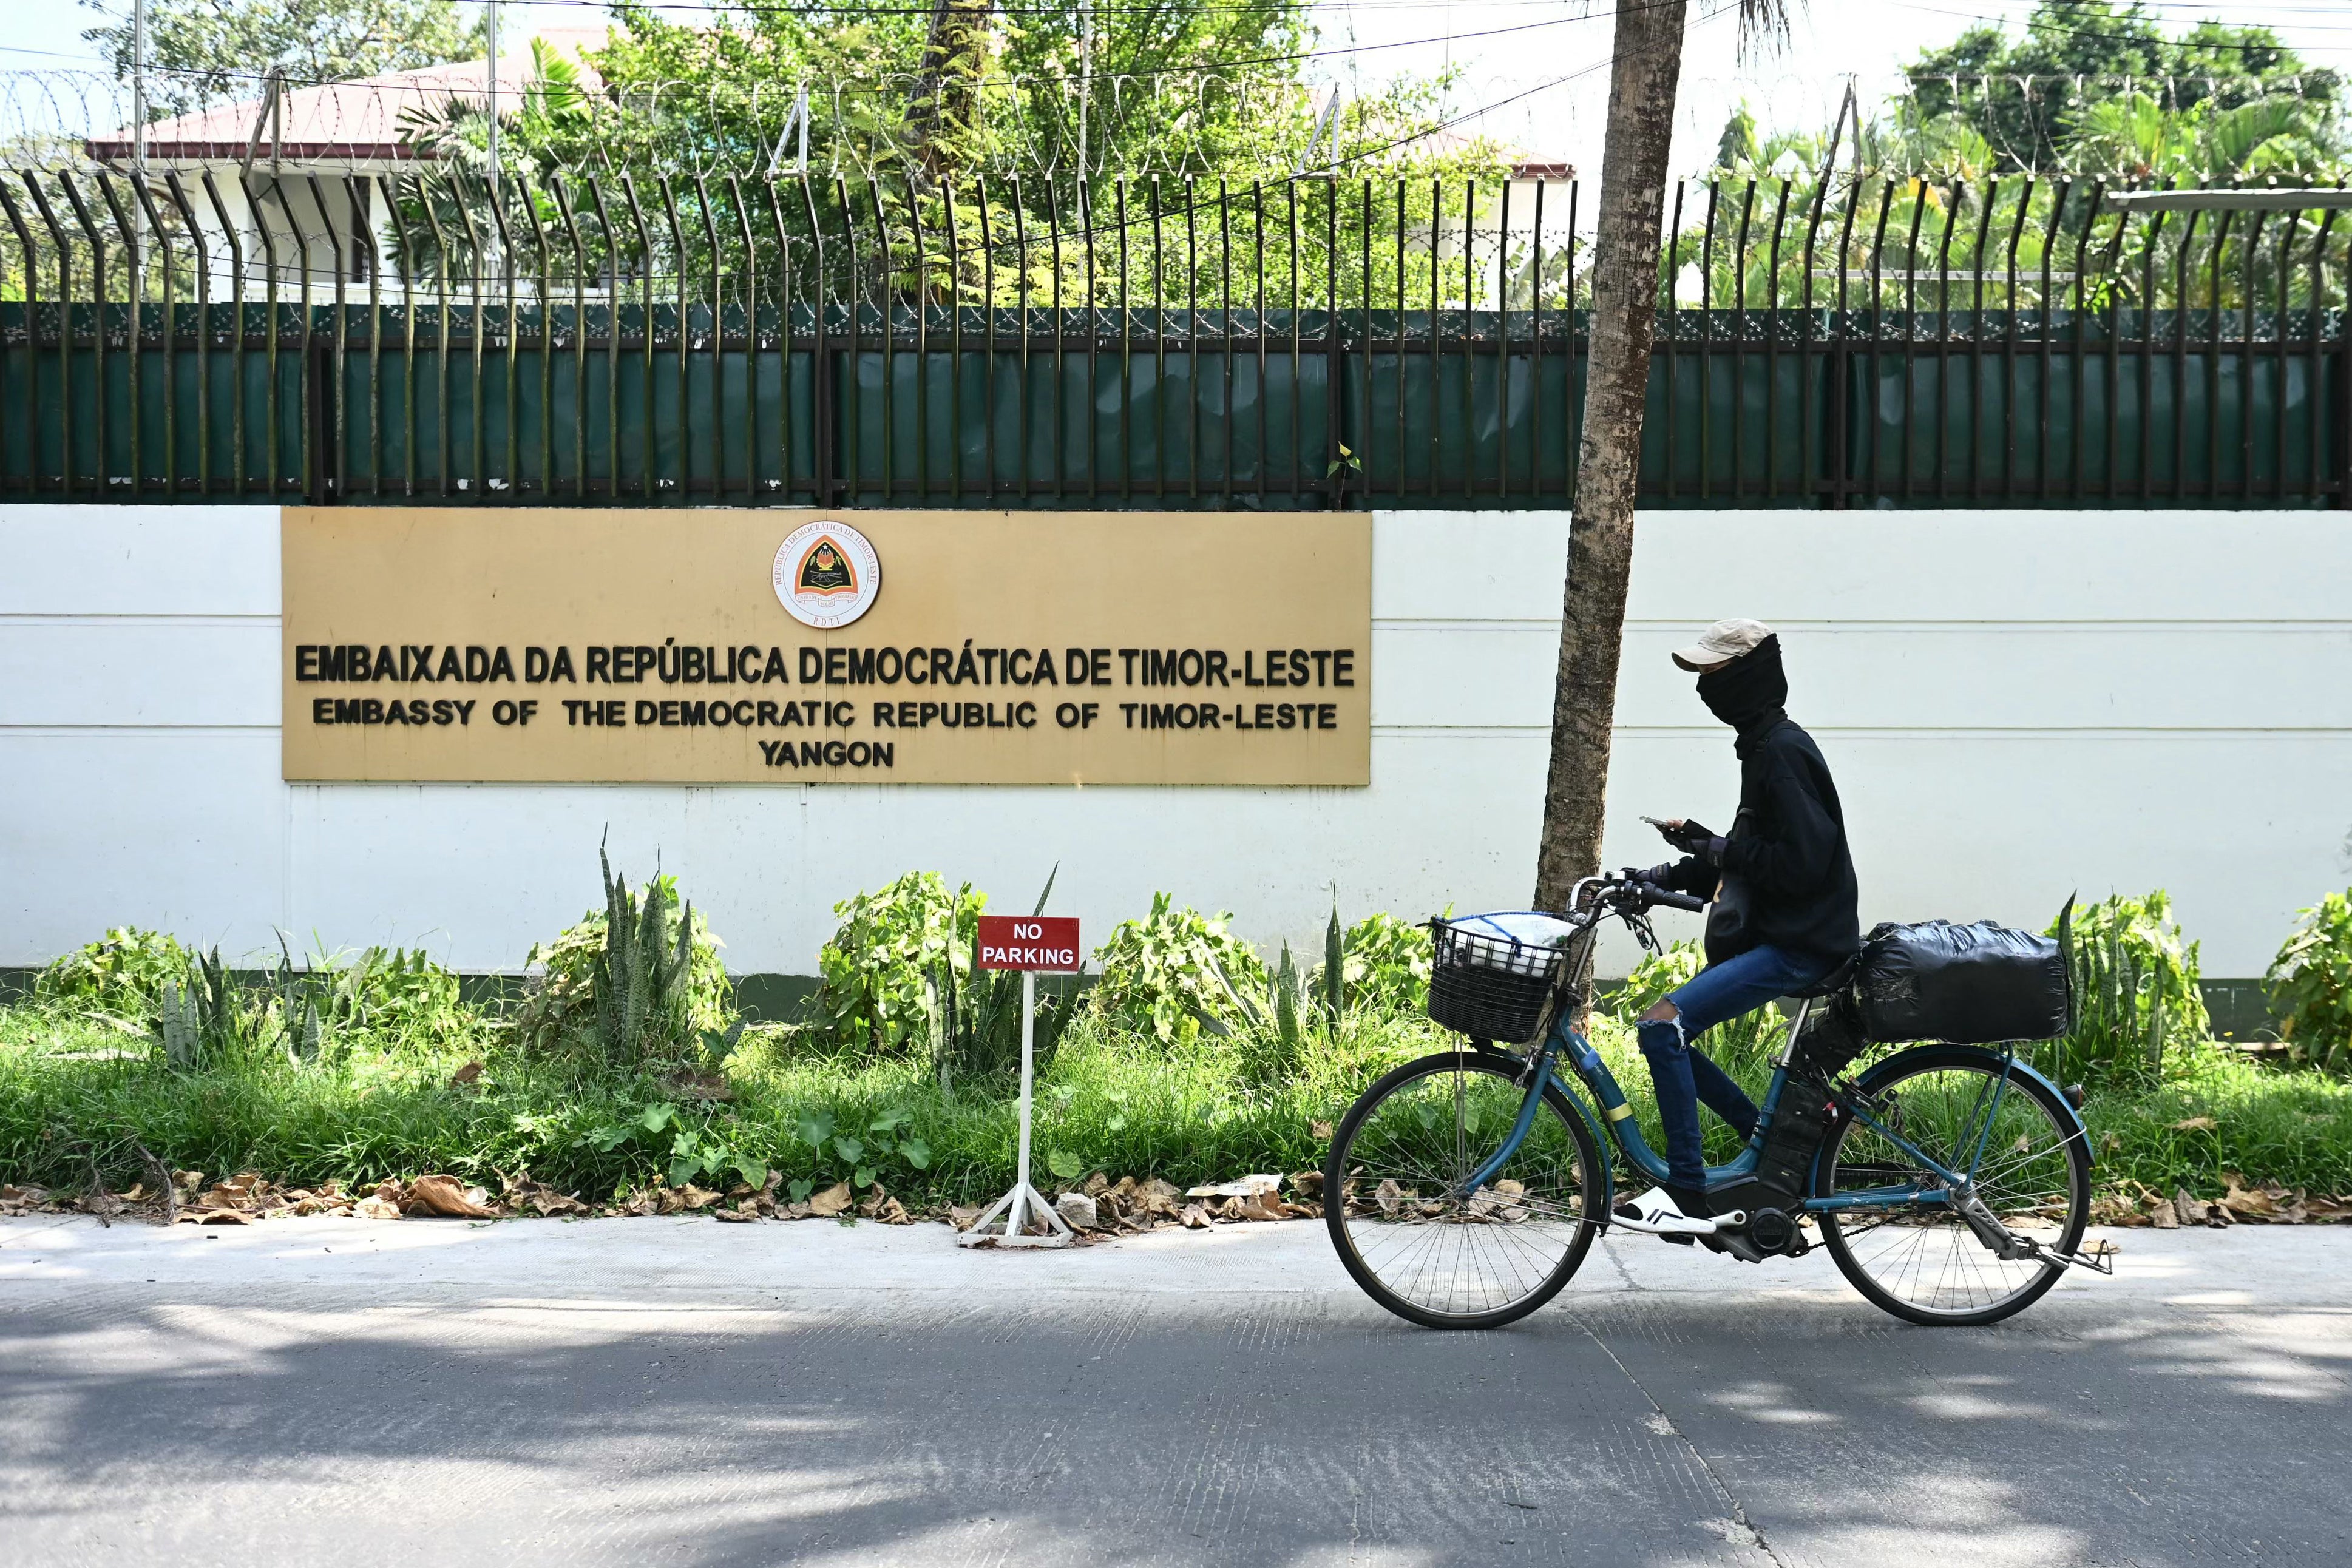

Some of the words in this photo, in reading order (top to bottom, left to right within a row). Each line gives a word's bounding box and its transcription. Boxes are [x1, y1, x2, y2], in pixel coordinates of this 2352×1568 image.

[844, 528, 856, 538] DE
[296, 645, 515, 683] EMBAIXADA
[526, 646, 576, 683] DA
[587, 638, 788, 684] REPÚBLICA
[799, 639, 1057, 686] DEMOCRÁTICA
[1066, 649, 1111, 685] DE
[1119, 649, 1354, 687] TIMOR-LESTE
[313, 699, 475, 726] EMBASSY
[492, 700, 538, 726] OF
[562, 700, 626, 727] THE
[635, 700, 855, 728] DEMOCRATIC
[873, 701, 1037, 729] REPUBLIC
[1056, 702, 1099, 729] OF
[1119, 703, 1337, 730] TIMOR-LESTE
[759, 741, 893, 768] YANGON
[1014, 924, 1042, 939] NO
[983, 947, 1073, 964] PARKING
